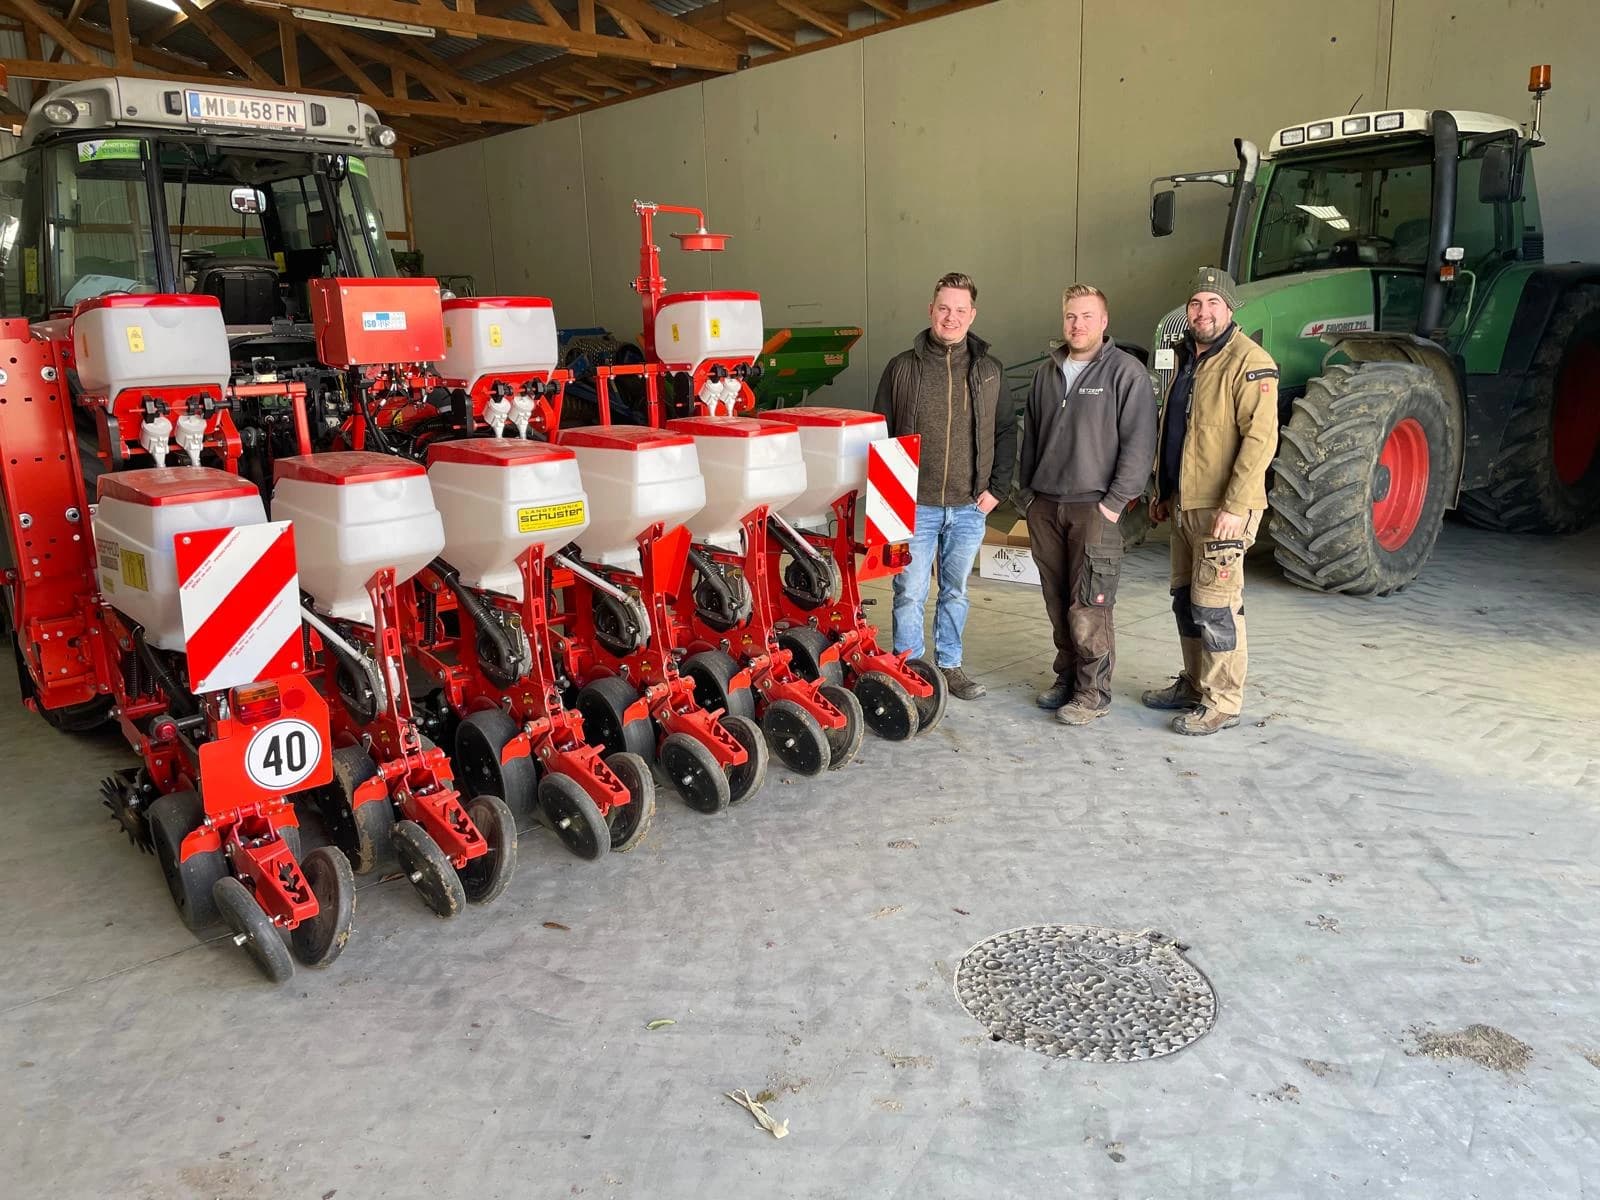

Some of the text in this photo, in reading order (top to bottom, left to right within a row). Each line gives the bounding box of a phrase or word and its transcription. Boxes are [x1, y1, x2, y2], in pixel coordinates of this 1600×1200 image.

[205, 97, 225, 117] MI
[1163, 333, 1185, 341] FEN
[263, 730, 306, 776] 40
